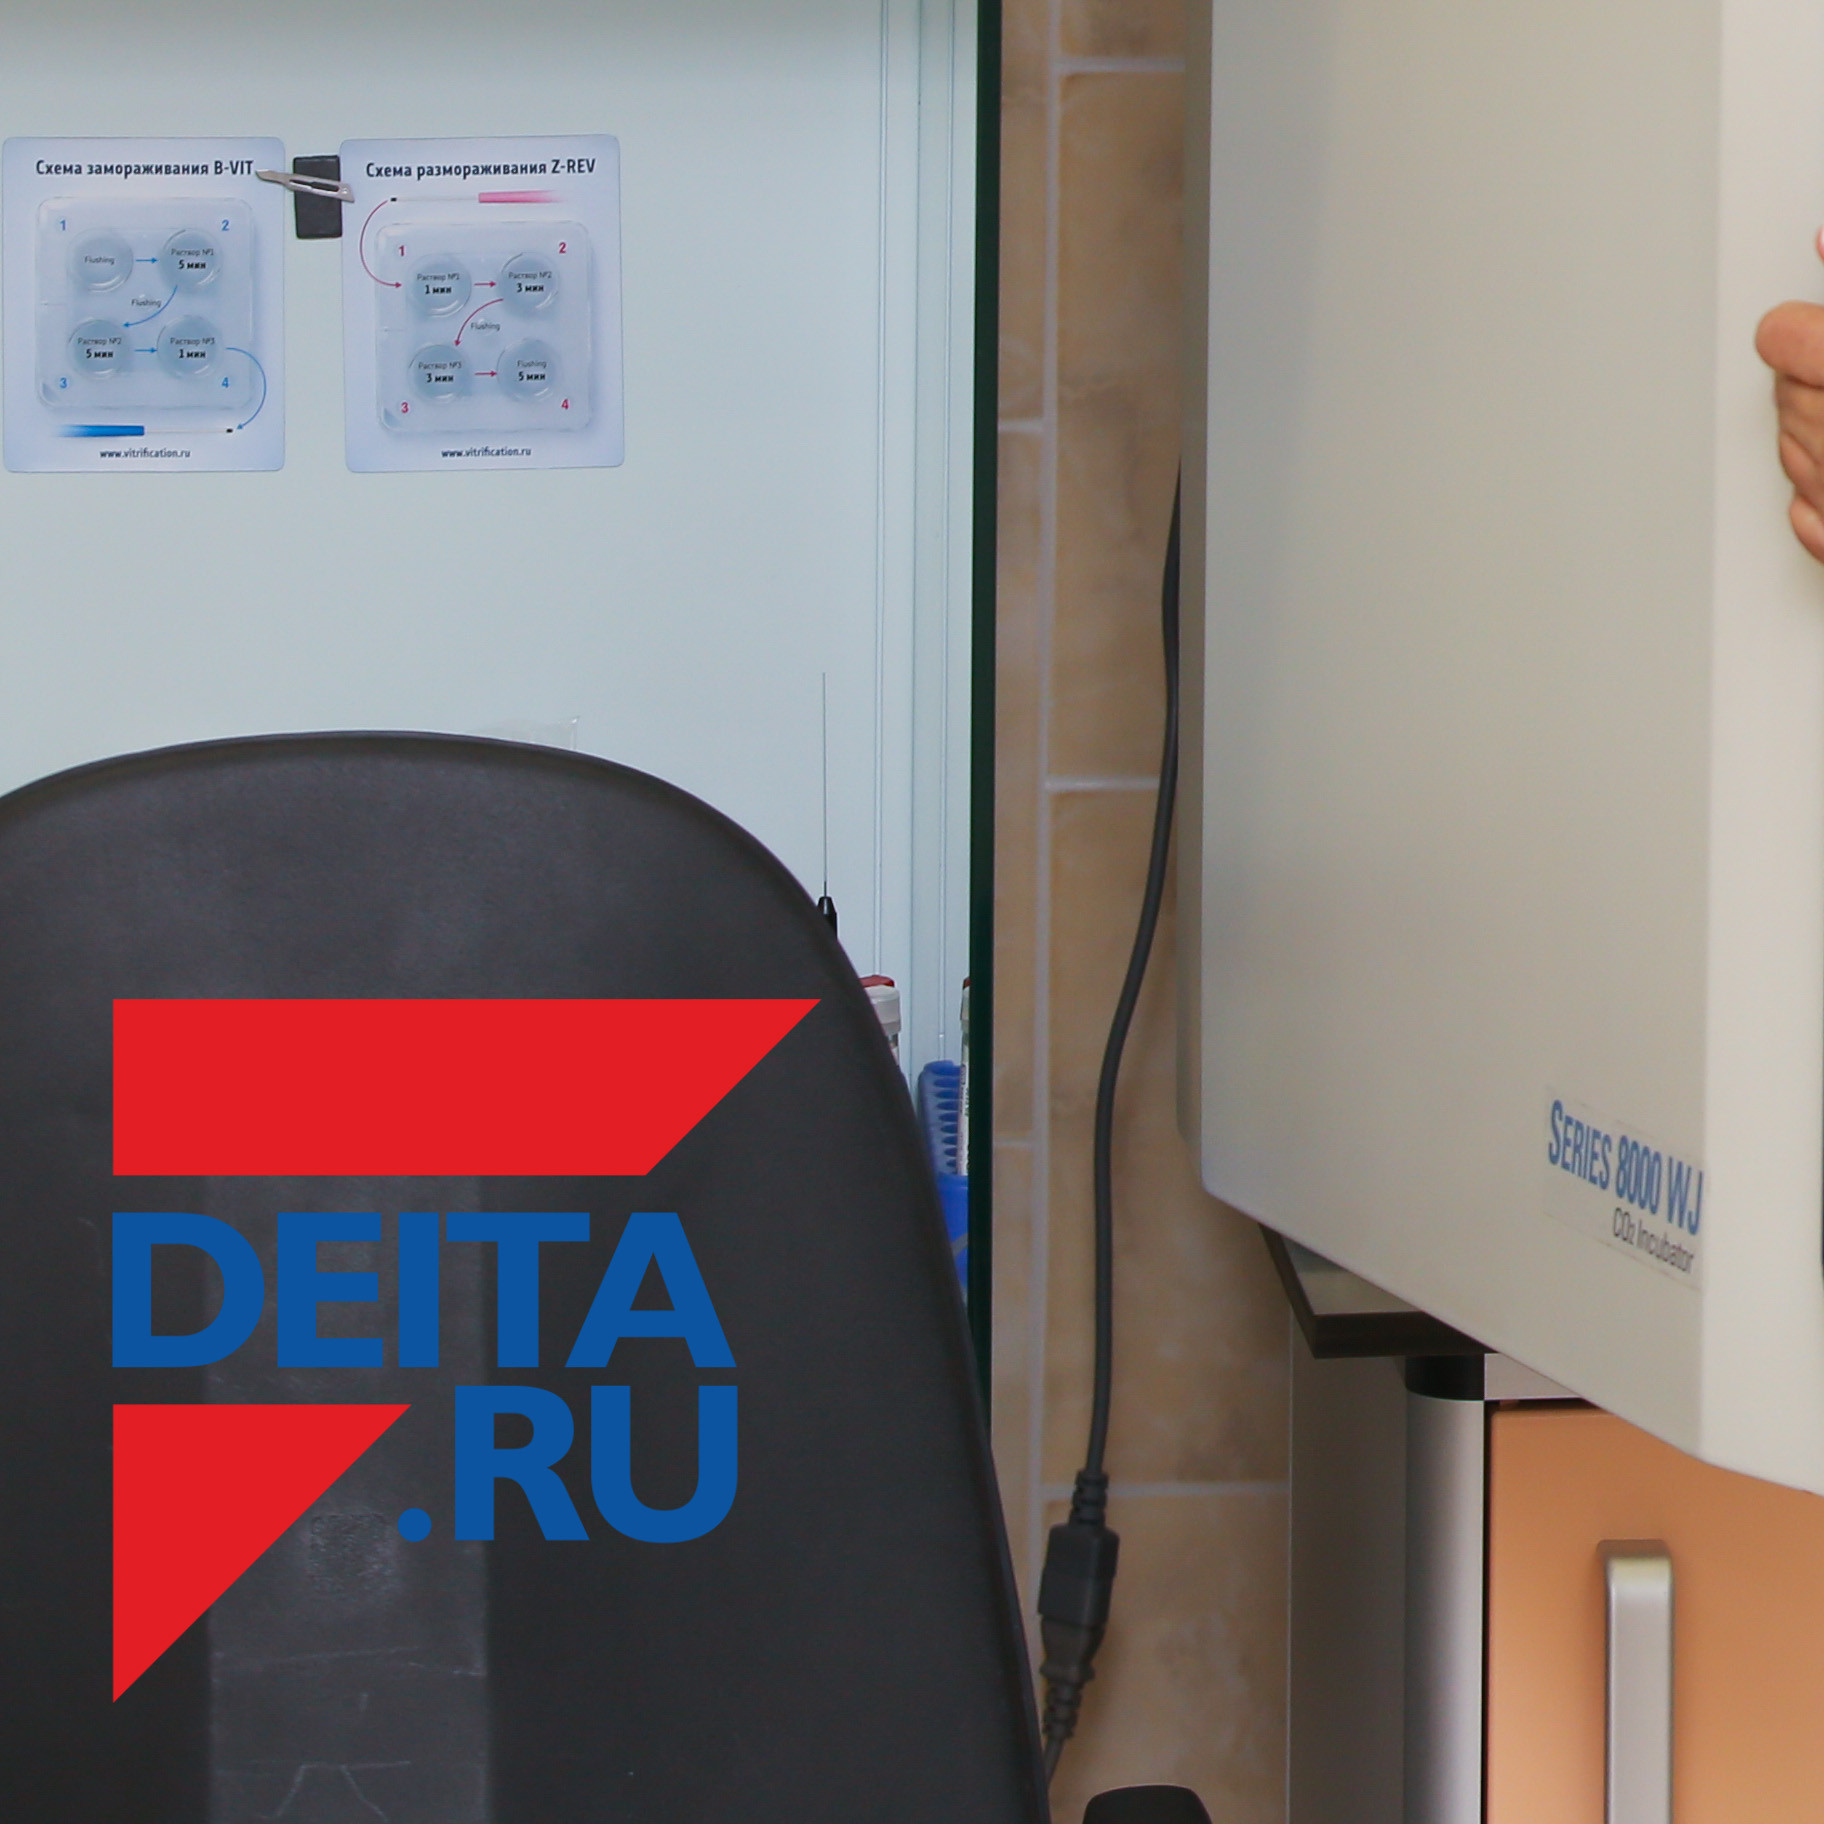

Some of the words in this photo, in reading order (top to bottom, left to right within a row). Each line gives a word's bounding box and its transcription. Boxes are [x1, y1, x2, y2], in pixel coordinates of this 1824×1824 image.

[36, 160, 82, 175] Схема
[87, 163, 208, 179] замораживания
[213, 160, 253, 175] B-VIT
[366, 162, 412, 177] Схема
[417, 162, 546, 180] размораживания
[551, 158, 596, 174] Z-REV
[60, 220, 66, 230] 1
[221, 219, 229, 231] 2
[399, 245, 405, 256] 1
[559, 242, 567, 253] 2
[85, 256, 115, 265] Flushing
[178, 260, 184, 269] 5
[187, 261, 206, 269] мин
[425, 285, 430, 294] 1
[433, 285, 452, 293] мин
[517, 283, 523, 292] 3
[525, 284, 544, 292] мин
[131, 299, 162, 308] Flushing
[471, 323, 500, 331] Flushing
[86, 349, 92, 358] 5
[94, 350, 113, 358] мин
[179, 349, 184, 358] 1
[186, 350, 206, 358] мин
[517, 360, 547, 369] Flushing
[427, 374, 432, 382] 3
[434, 374, 453, 382] мин
[518, 372, 524, 380] 5
[60, 378, 67, 388] 3
[222, 378, 229, 388] 4
[401, 402, 409, 413] 3
[561, 399, 569, 410] 4
[100, 448, 190, 458] www.vitrification.ru
[442, 447, 531, 458] www.vitrification.ru
[1548, 1099, 1612, 1190] SERIES
[1616, 1135, 1662, 1214] 8000
[1668, 1156, 1704, 1236] WJ
[1637, 1219, 1694, 1274] Incubator
